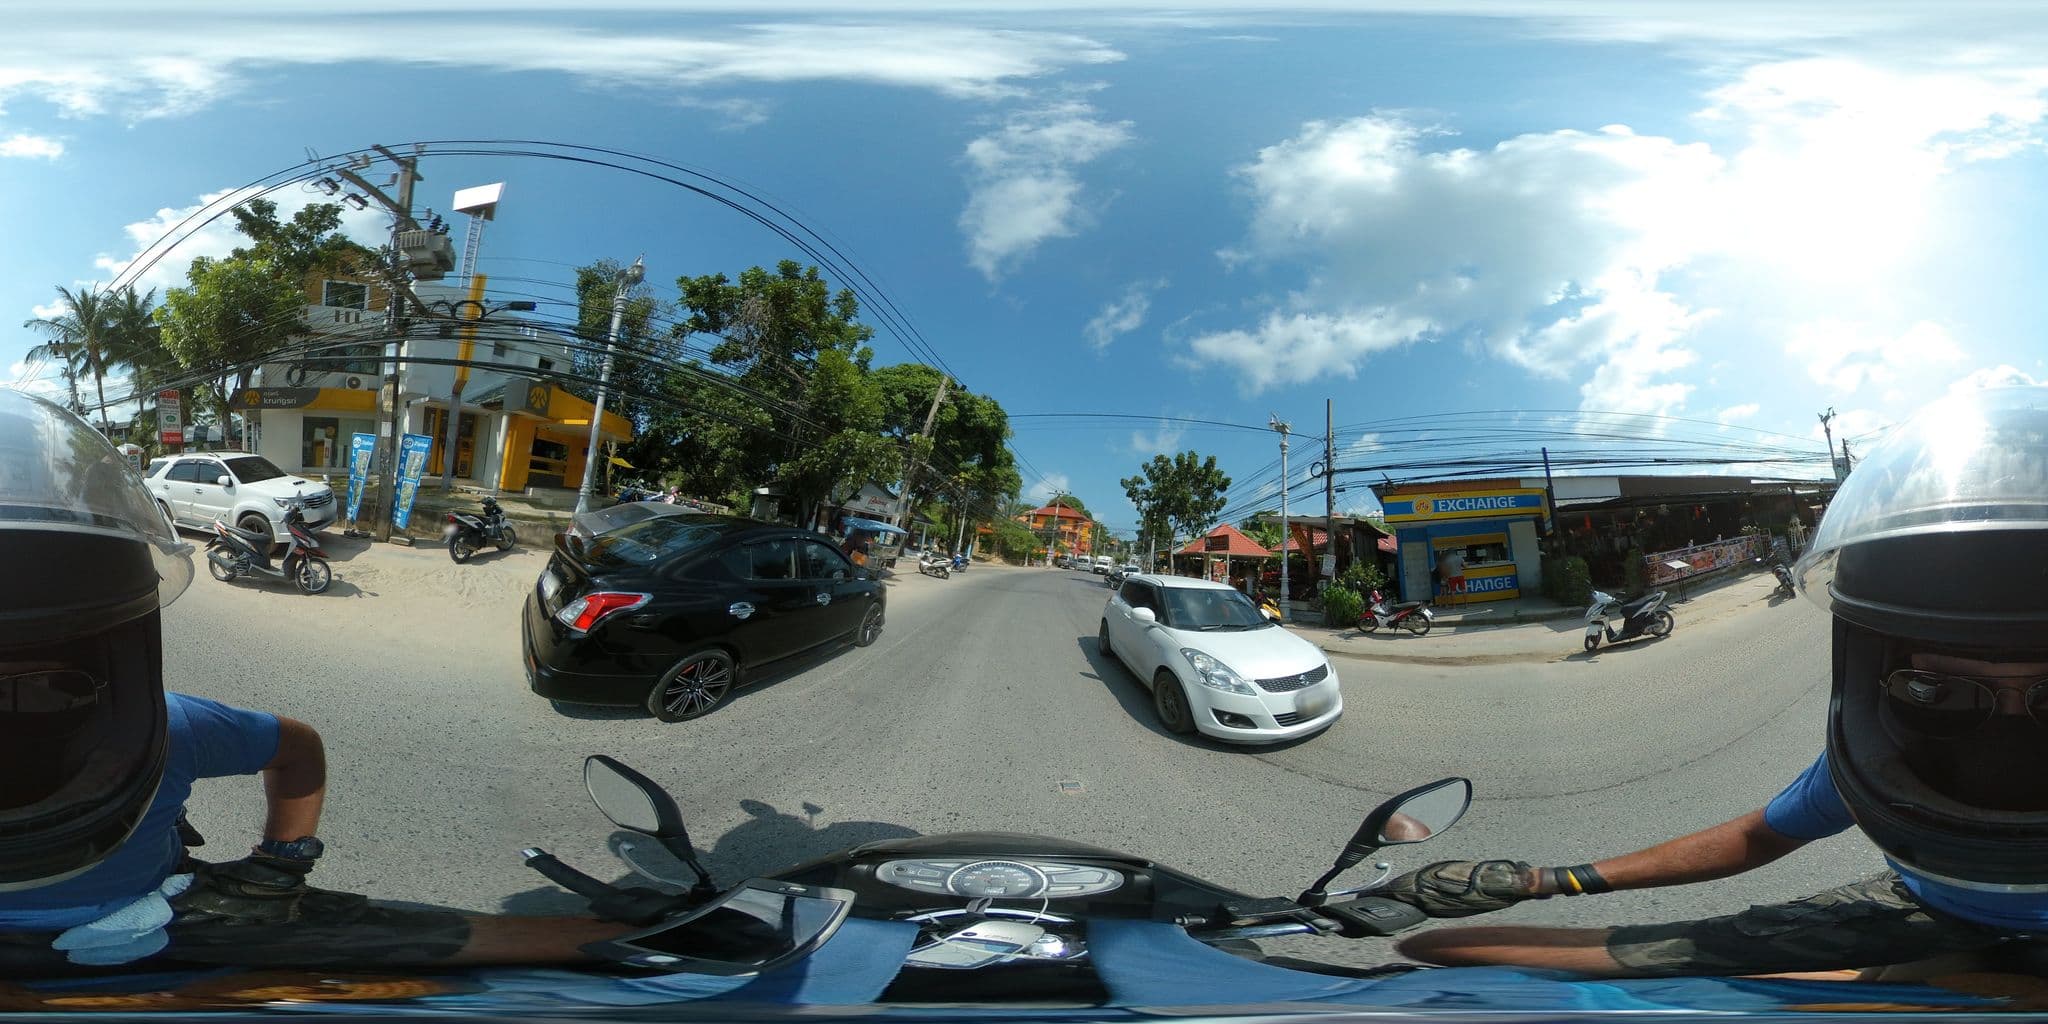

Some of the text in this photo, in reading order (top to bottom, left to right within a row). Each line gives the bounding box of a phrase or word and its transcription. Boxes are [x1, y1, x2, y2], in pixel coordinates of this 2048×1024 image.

[263, 397, 297, 406] krungsri
[1438, 496, 1516, 511] EXCHANGE
[1455, 577, 1512, 592] CHANGE
